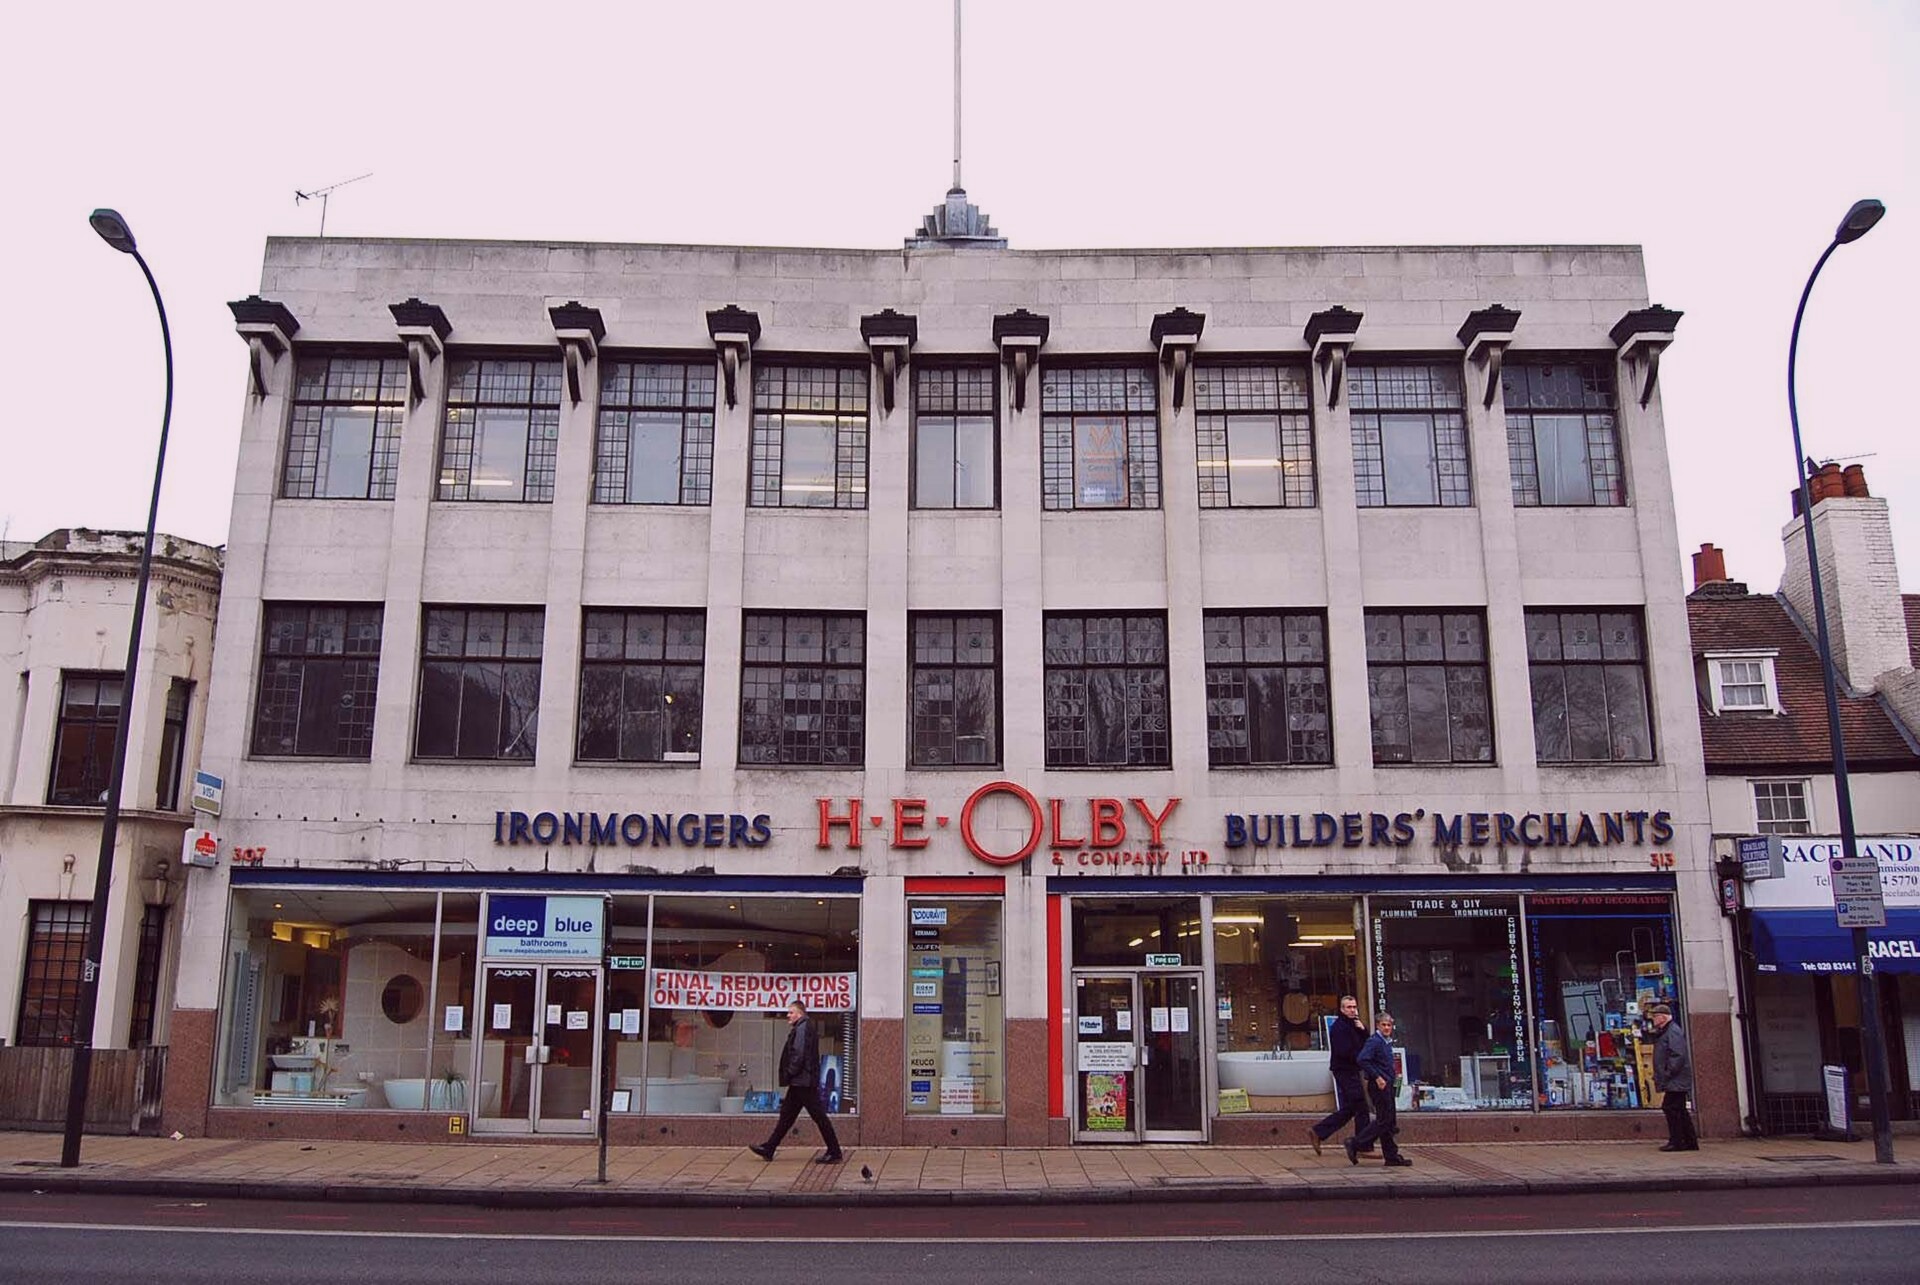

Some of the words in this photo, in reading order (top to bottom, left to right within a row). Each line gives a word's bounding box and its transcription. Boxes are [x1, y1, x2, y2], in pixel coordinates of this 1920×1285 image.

[203, 786, 214, 798] VISA
[494, 811, 772, 847] IRONMONGERS
[1224, 808, 1425, 847] BUILDERS'
[1432, 809, 1674, 847] MERCHANTS
[233, 847, 266, 862] 307
[1052, 852, 1064, 866] &
[1078, 852, 1170, 866] COMPANY
[1182, 850, 1210, 864] LTD
[1650, 852, 1675, 867] 313
[1891, 875, 1917, 886] 5770
[1410, 900, 1445, 909] TRADE
[1450, 900, 1458, 909] &
[1463, 899, 1481, 908] DIY
[1532, 896, 1578, 904] PAINTING
[1582, 896, 1601, 904] AND
[1605, 895, 1668, 904] DECORATING
[1454, 908, 1508, 917] IRONMONGERY
[494, 915, 539, 936] deep
[555, 917, 593, 932] blue
[520, 939, 568, 947] bathrooms
[630, 959, 643, 968] EXIT
[656, 972, 714, 990] FINAL
[721, 975, 849, 992] REDUCTIONS
[654, 990, 680, 1005] ON
[686, 991, 790, 1008] EX-DISPLAY
[796, 992, 851, 1008] ITEMS
[911, 1059, 935, 1067] KEUCO
